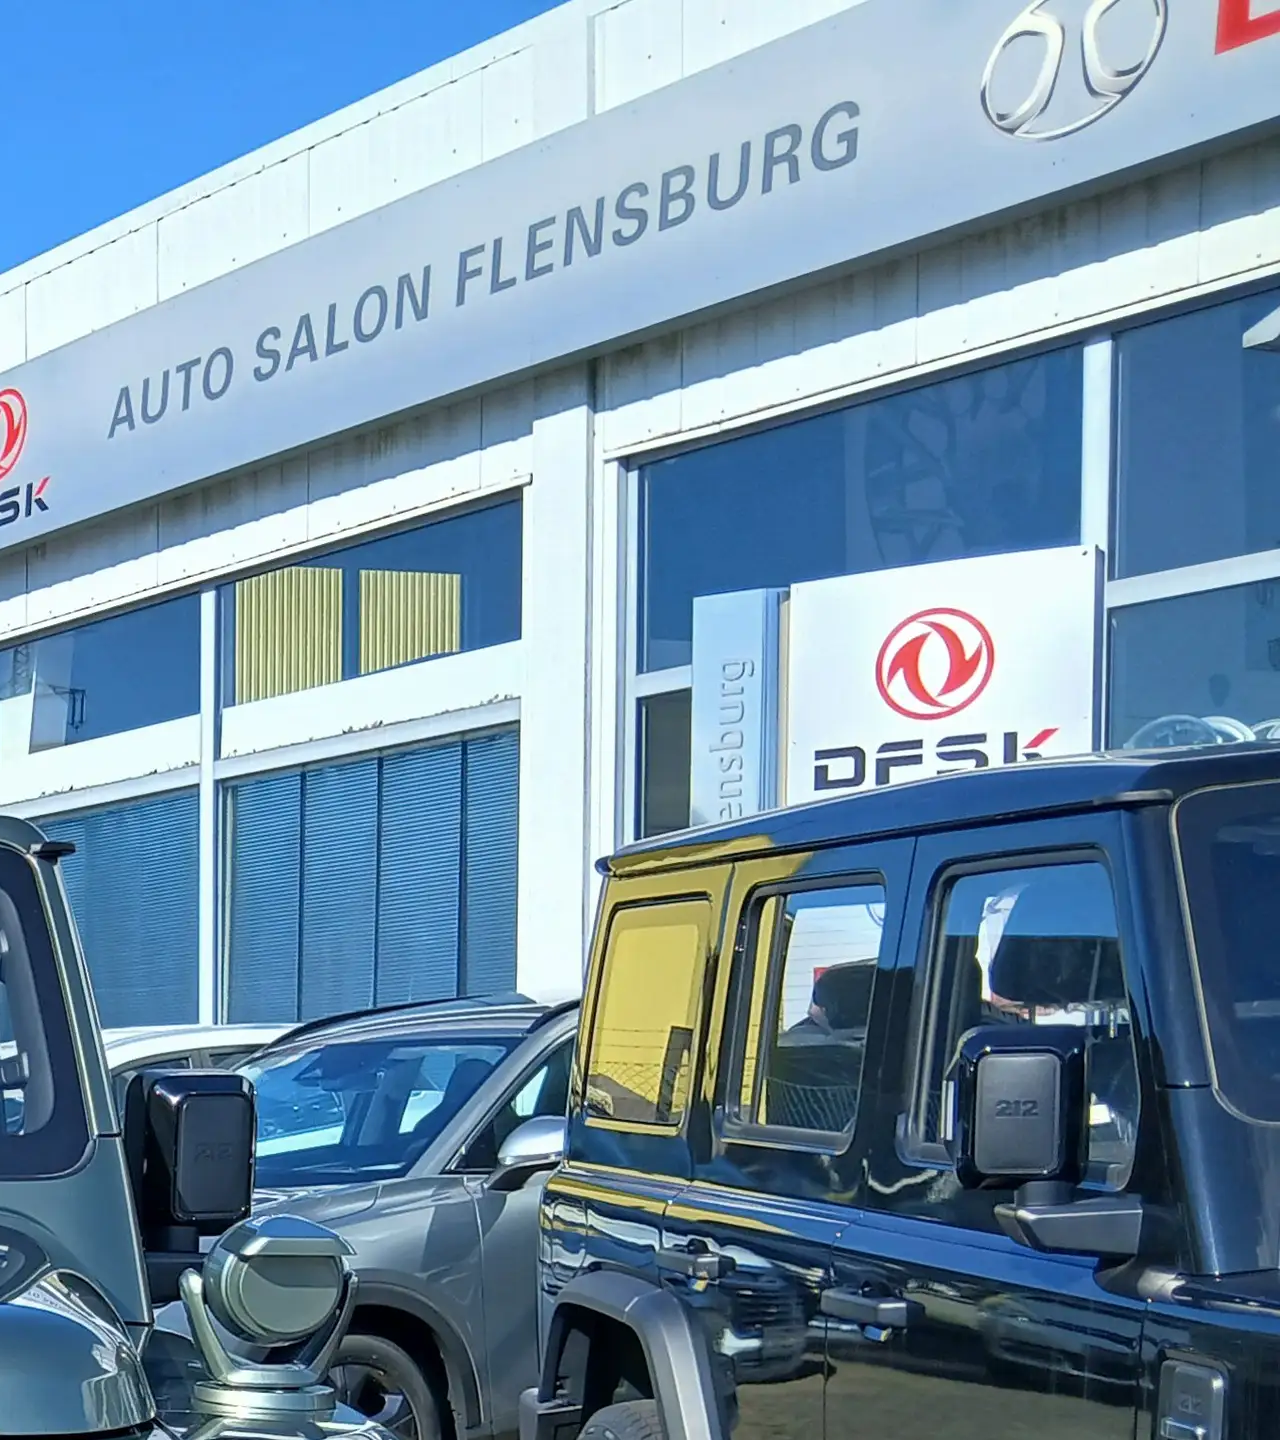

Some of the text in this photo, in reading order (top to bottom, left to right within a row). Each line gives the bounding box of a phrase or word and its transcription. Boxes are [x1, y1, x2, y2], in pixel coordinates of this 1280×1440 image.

[107, 100, 861, 439] AUTO SALON FLENSBURG
[814, 727, 1060, 791] DFSK
[995, 1099, 1039, 1118] 212
